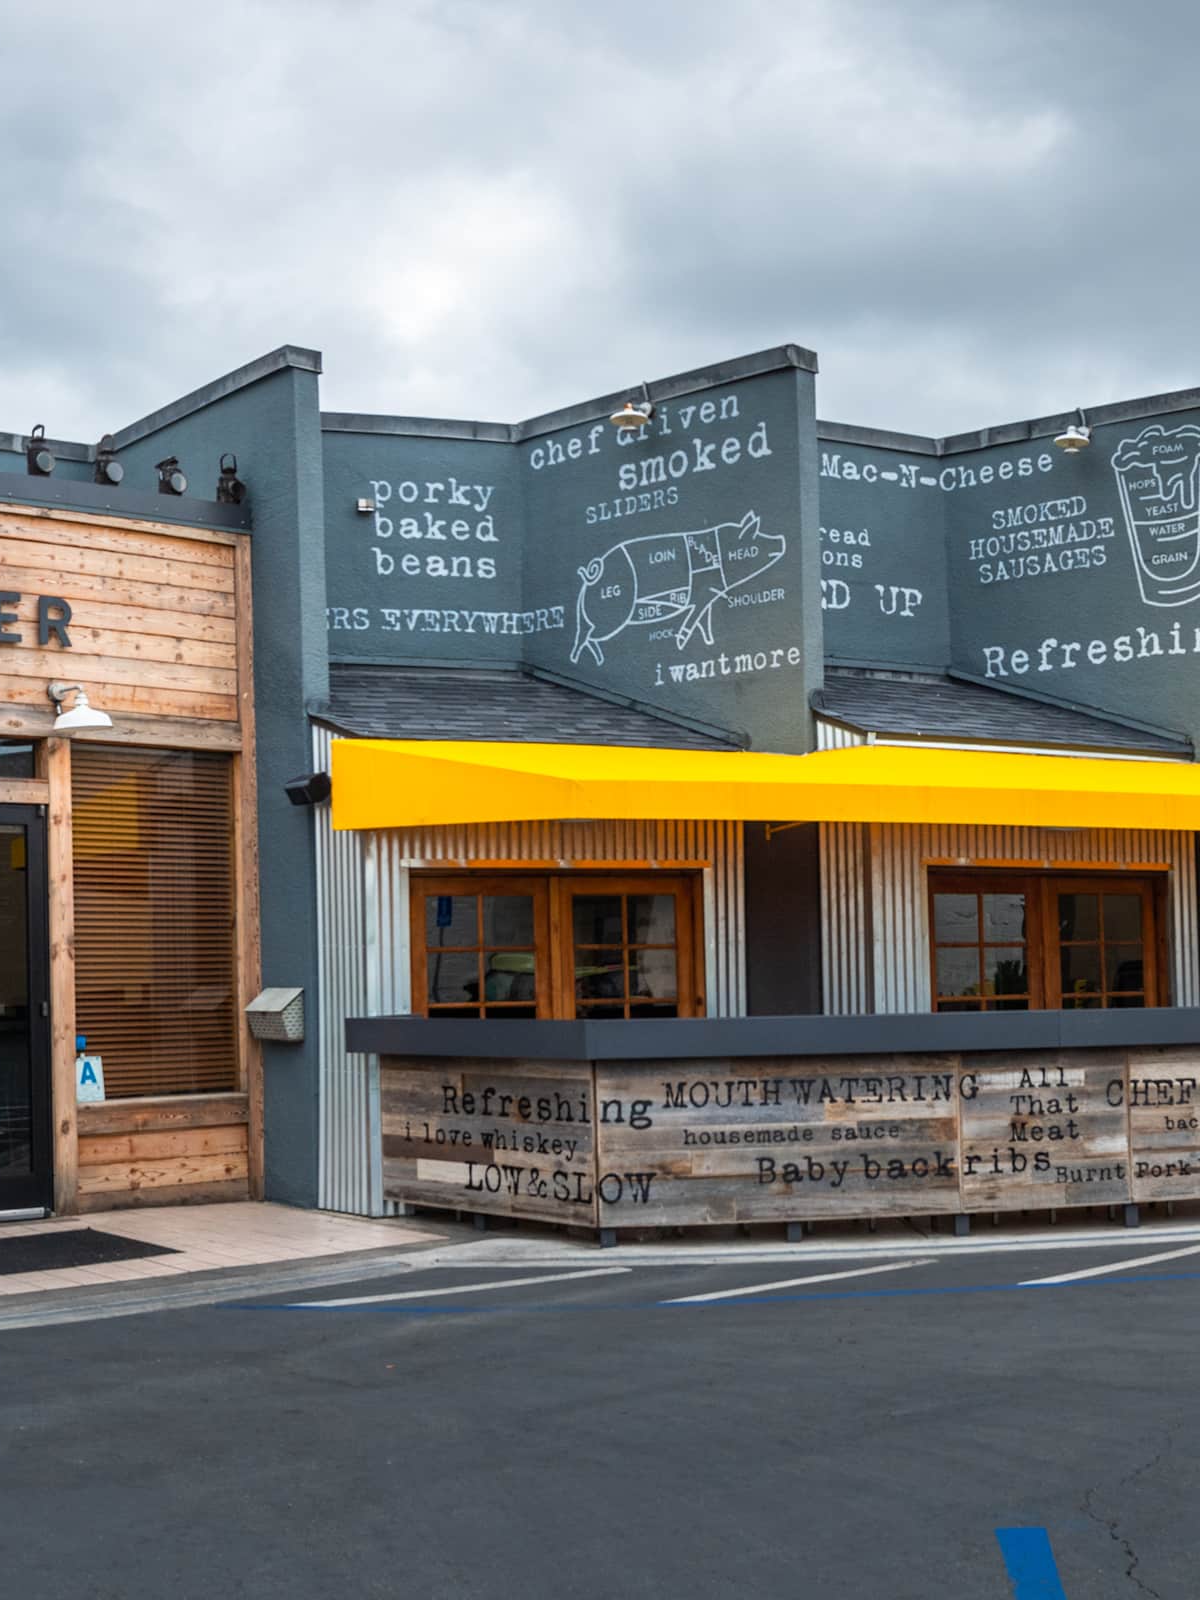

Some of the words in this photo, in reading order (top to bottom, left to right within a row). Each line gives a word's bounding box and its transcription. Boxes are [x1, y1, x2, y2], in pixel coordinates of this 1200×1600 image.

[531, 427, 604, 470] chef
[619, 423, 772, 490] smoked
[1152, 443, 1184, 456] FOAM
[820, 453, 1053, 491] Mac-N-Cheese
[370, 478, 496, 512] porky
[1129, 478, 1156, 491] HOPS
[586, 486, 679, 524] SLIDERS
[992, 496, 1087, 530] SMOKED
[1145, 503, 1180, 518] YEAST
[375, 511, 499, 542] baked
[1149, 522, 1185, 536] WATER
[969, 517, 1115, 561] HOUSEMADE
[371, 548, 497, 578] beans
[649, 549, 676, 564] LOIN
[687, 535, 720, 568] BLADE
[728, 546, 759, 561] HEAD
[1151, 551, 1189, 566] GRAIN
[979, 545, 1107, 584] SAUSAGES
[601, 585, 621, 599] LEG
[669, 592, 687, 604] RIB
[727, 588, 785, 609] SHOULDER
[874, 584, 923, 616] UP
[380, 606, 565, 635] EVERYWHERE
[638, 606, 663, 620] SIDE
[80, 1061, 97, 1085] A
[1019, 1067, 1069, 1089] All
[1106, 1078, 1196, 1107] CHEF
[441, 1086, 653, 1130] Refreshing
[1010, 1094, 1080, 1116] That
[403, 1122, 412, 1143] i
[422, 1123, 473, 1148] love
[480, 1128, 578, 1162] whiskey
[683, 1124, 814, 1145] housemade
[831, 1124, 901, 1142] sauce
[1008, 1120, 1080, 1142] Meat
[1055, 1163, 1126, 1184] Burnt
[1134, 1160, 1191, 1178] Pork
